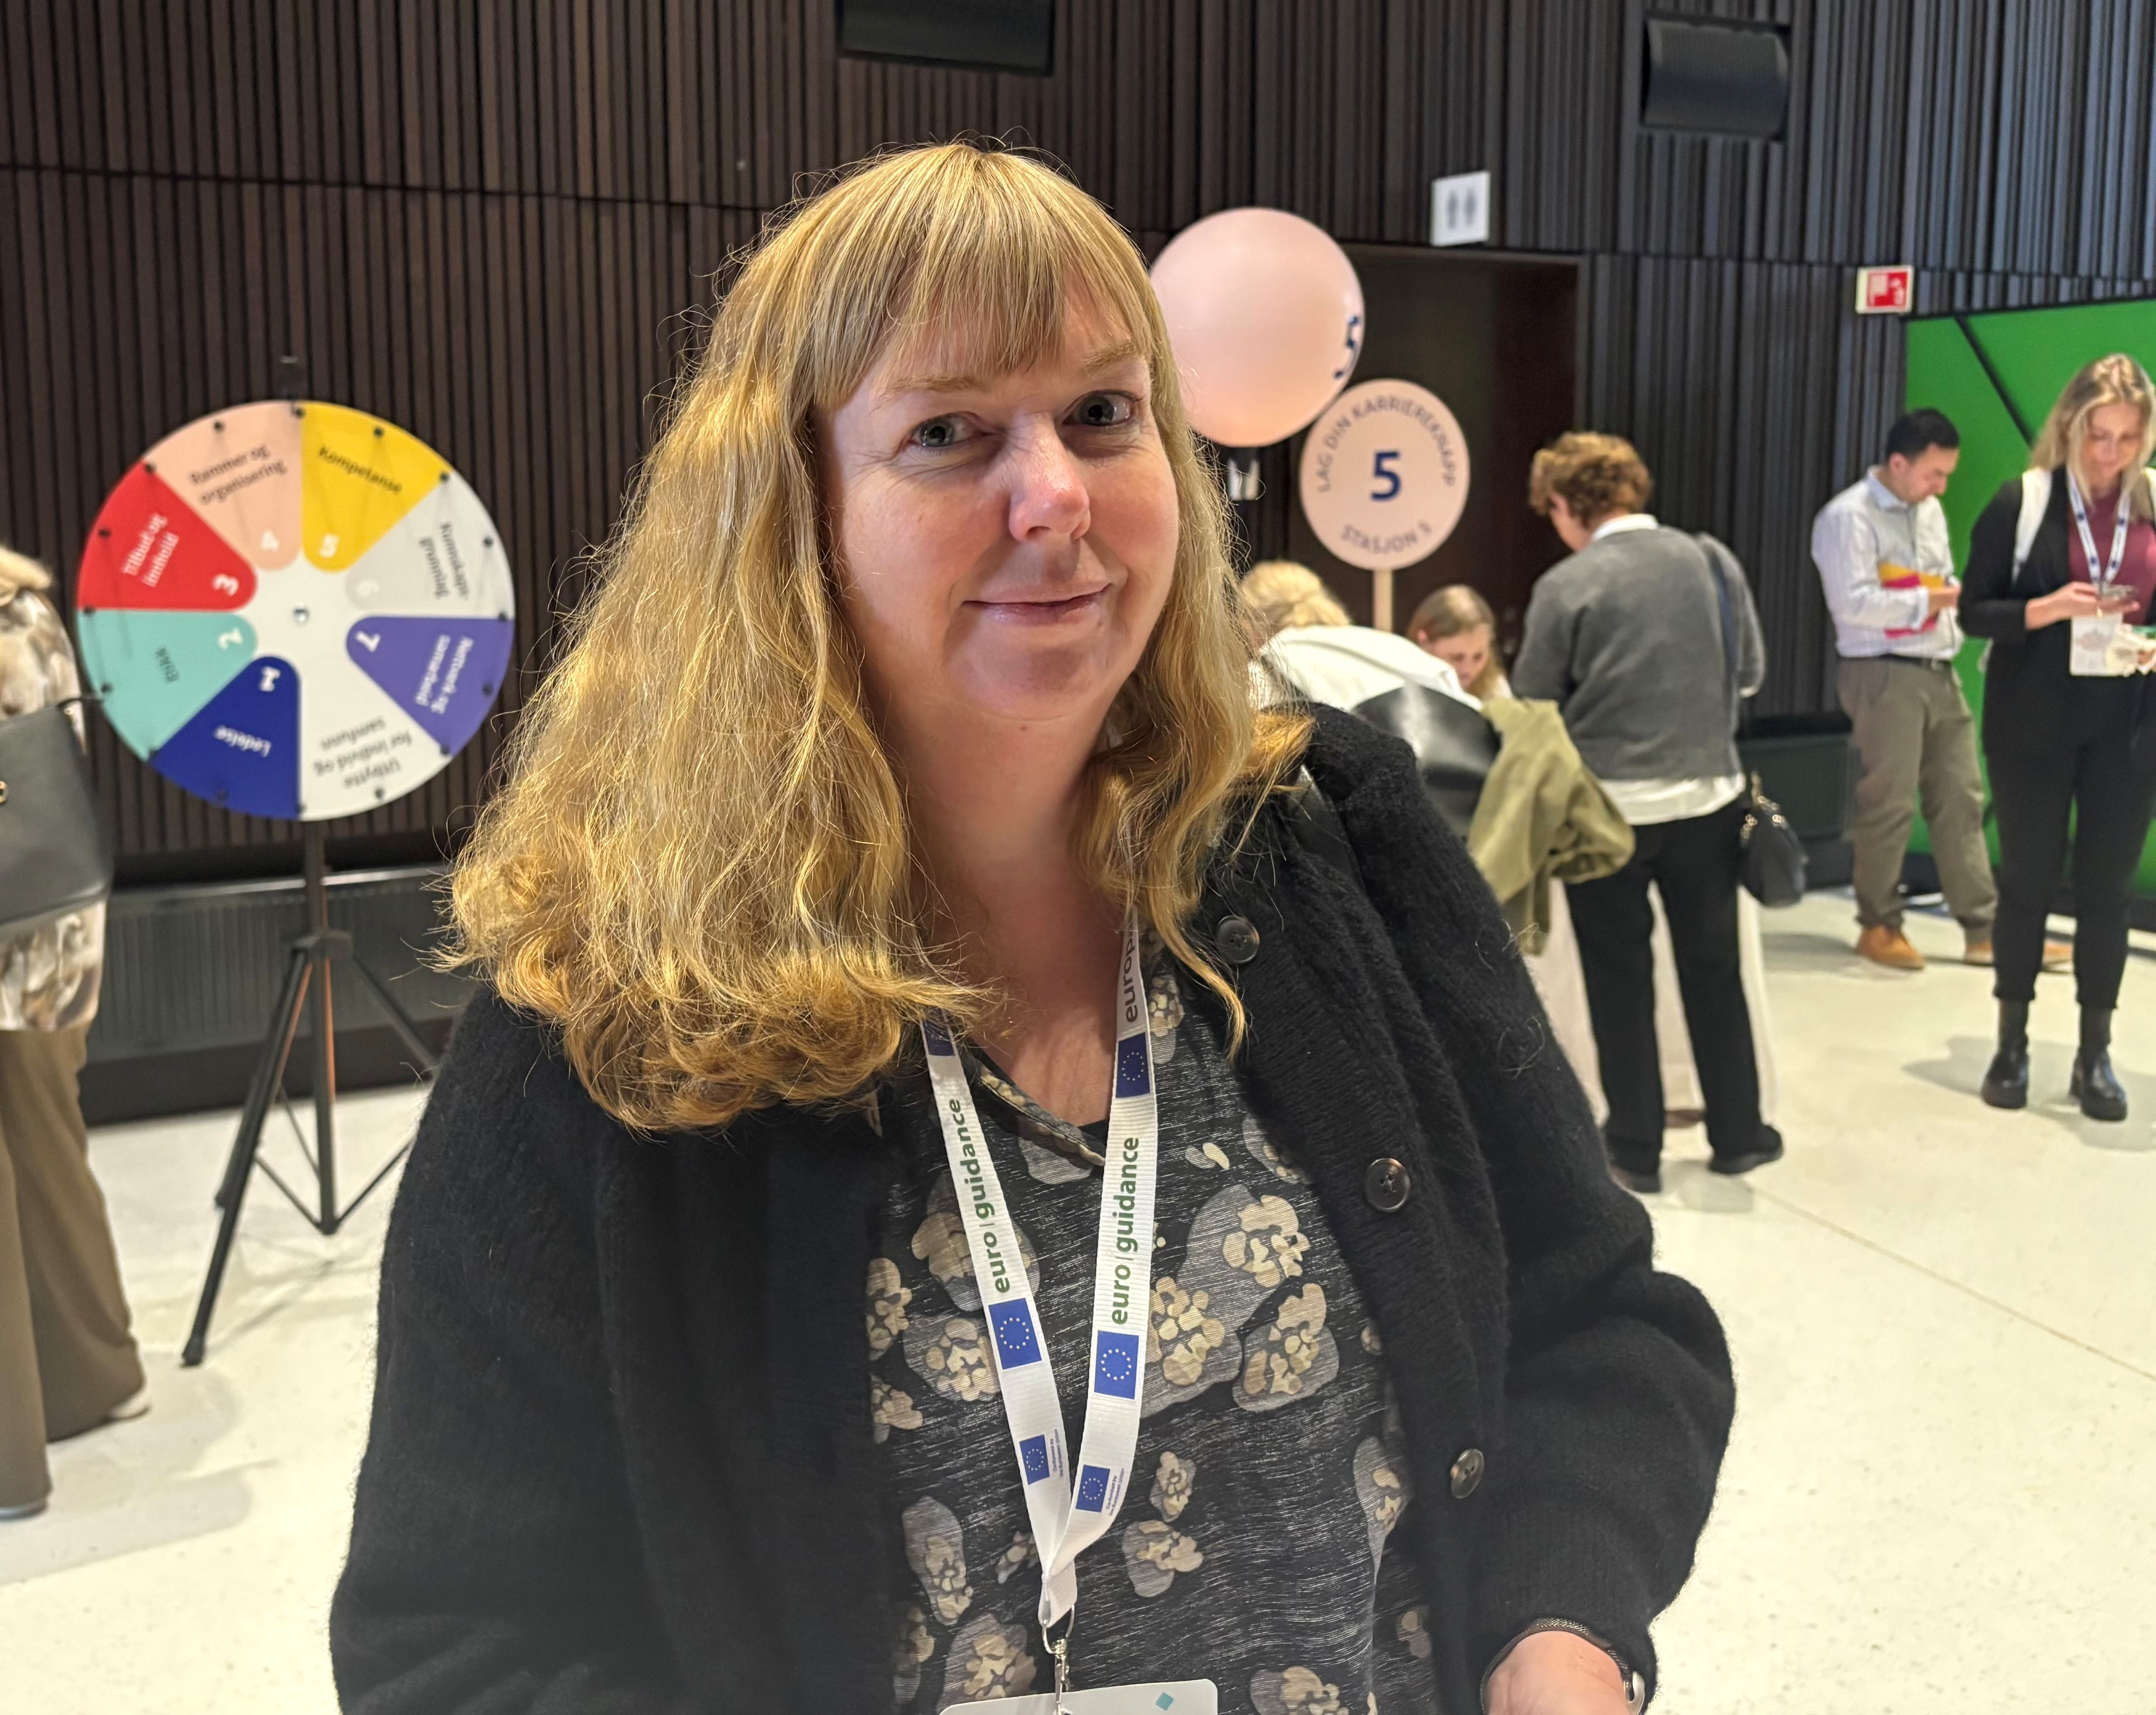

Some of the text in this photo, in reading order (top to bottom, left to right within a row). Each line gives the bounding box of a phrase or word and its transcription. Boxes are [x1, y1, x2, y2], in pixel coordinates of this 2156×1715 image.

[189, 444, 270, 486] Rammer og
[319, 446, 402, 495] Kompetanse
[1317, 453, 1333, 492] LAG
[1325, 416, 1351, 449] DIN
[201, 459, 287, 505] organisering
[1371, 451, 1401, 501] 5
[121, 513, 168, 575] Tilbud og
[261, 529, 280, 552] 4
[319, 534, 340, 558] 5
[1342, 524, 1418, 554] STASJON
[418, 536, 450, 599] grunnlag
[213, 574, 239, 596] 3
[218, 627, 243, 649] 2
[356, 631, 381, 652] 7
[260, 666, 280, 692] 1
[415, 634, 451, 707] samarbeid
[430, 693, 449, 715] og
[214, 725, 271, 757] Ledelse
[321, 716, 386, 750] samfunn
[314, 730, 412, 776] for individ og
[344, 757, 400, 789] Utbytte
